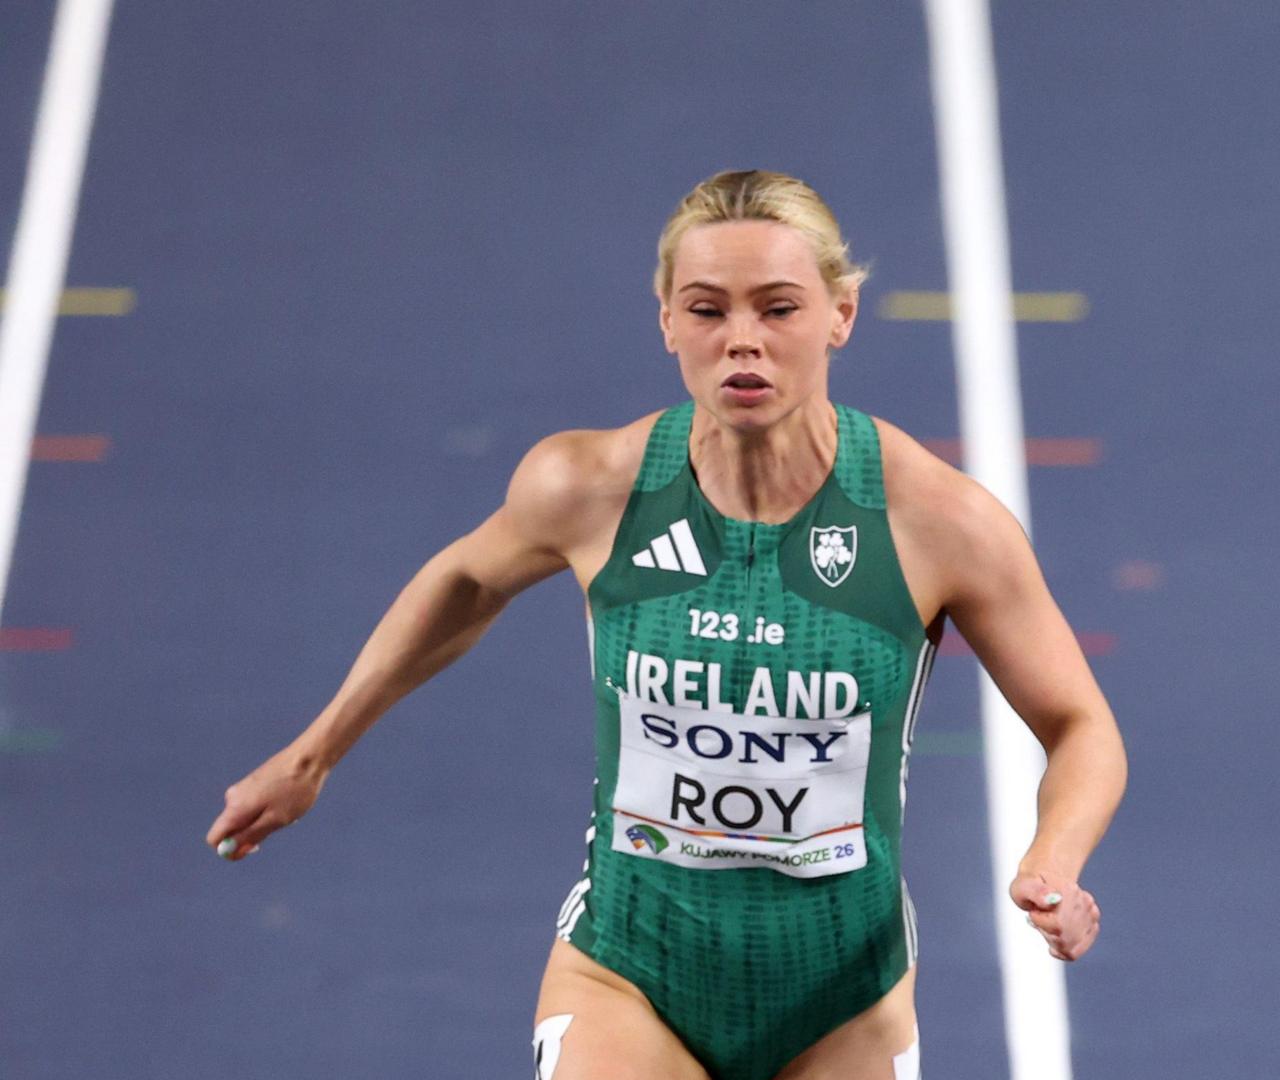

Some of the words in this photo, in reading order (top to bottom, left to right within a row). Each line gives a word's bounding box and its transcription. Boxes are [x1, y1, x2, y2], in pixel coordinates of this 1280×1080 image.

[625, 650, 860, 719] IRELAND
[640, 713, 848, 763] SONY
[669, 772, 809, 834] ROY
[680, 842, 746, 860] KUJAWY
[834, 843, 855, 859] 26
